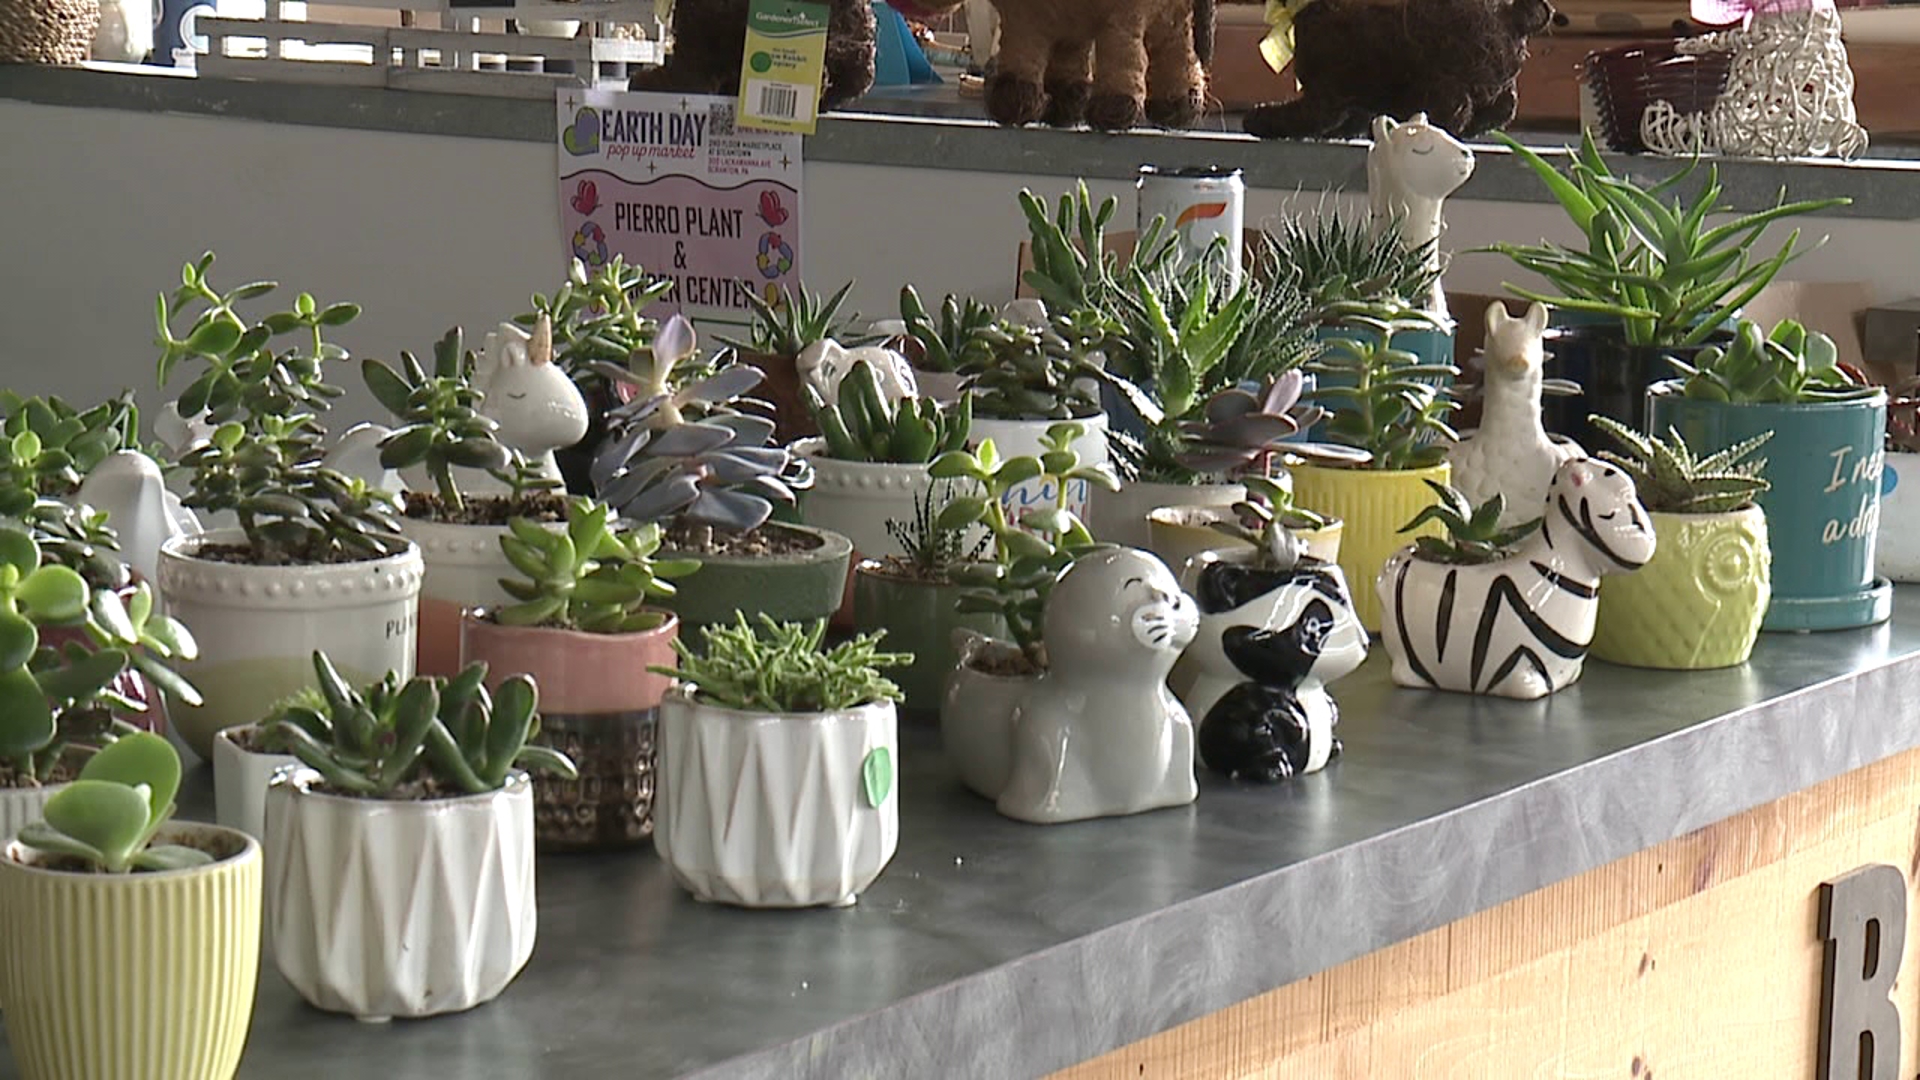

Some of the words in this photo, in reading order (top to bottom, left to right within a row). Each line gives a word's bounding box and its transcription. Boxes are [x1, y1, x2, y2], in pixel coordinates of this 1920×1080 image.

[601, 109, 663, 145] EARTH
[669, 111, 707, 147] DAY
[606, 144, 630, 161] pop
[631, 145, 647, 162] up
[648, 143, 696, 159] market
[615, 202, 680, 235] PIERRO
[685, 205, 743, 240] PLANT
[674, 240, 687, 270] &
[686, 275, 756, 310] CENTER
[1823, 445, 1853, 493] I
[1821, 518, 1848, 545] a
